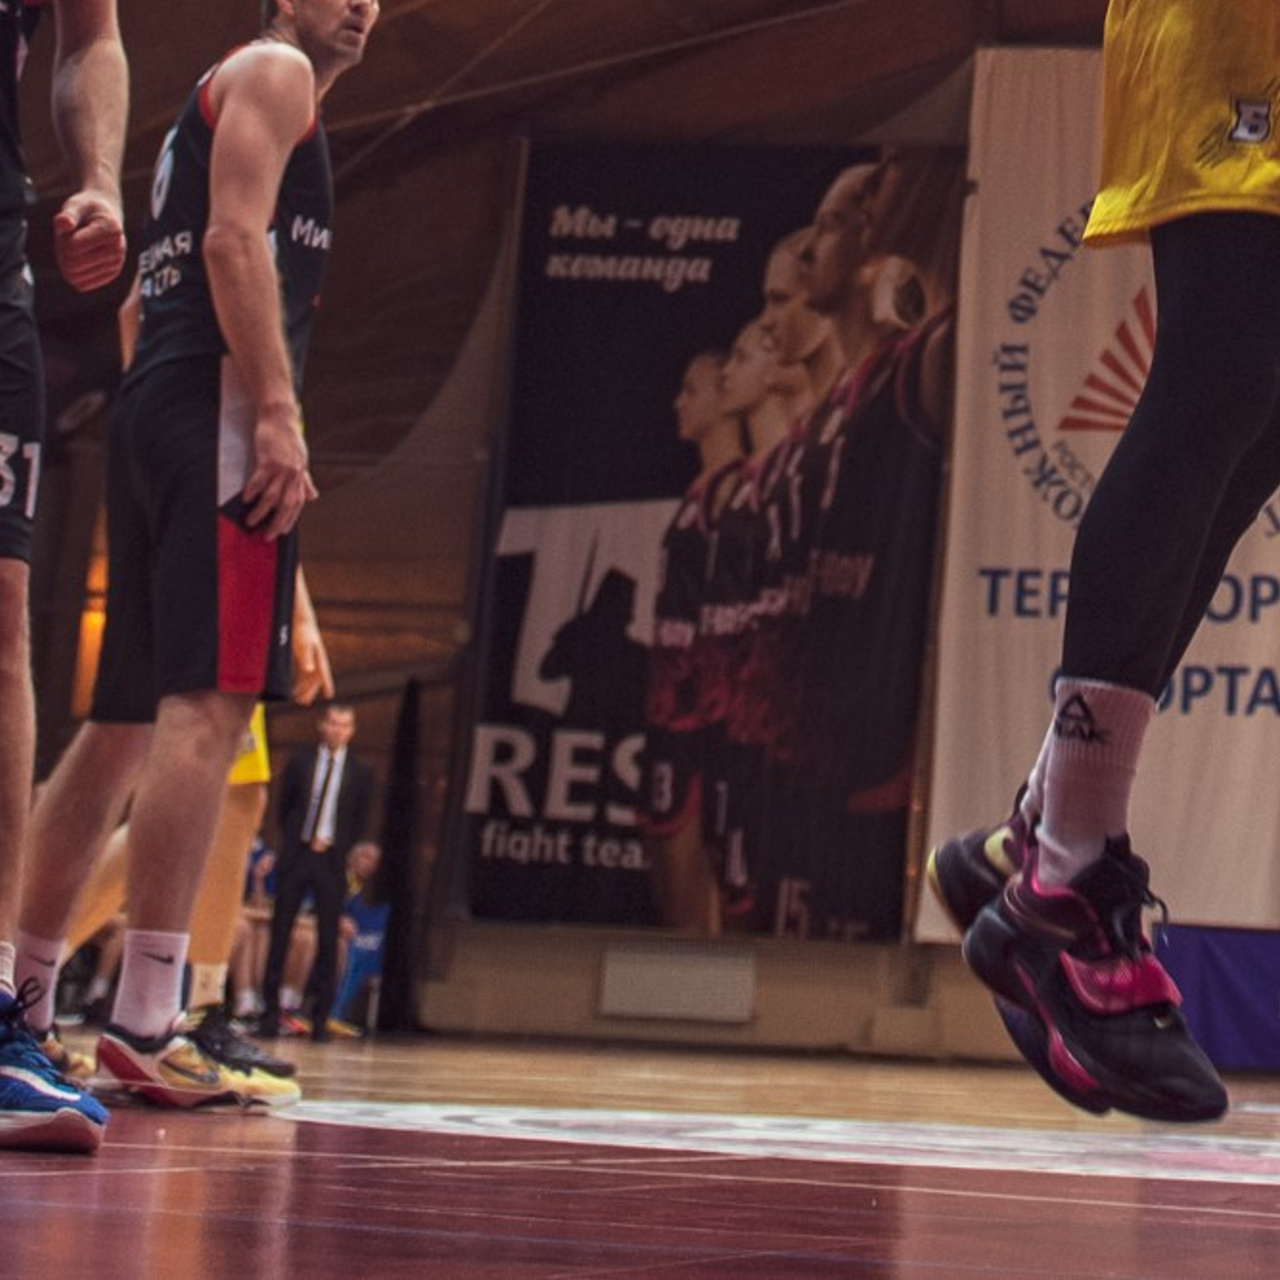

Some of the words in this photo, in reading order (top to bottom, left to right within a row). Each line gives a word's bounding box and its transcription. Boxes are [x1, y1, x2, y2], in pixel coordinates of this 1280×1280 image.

[551, 206, 617, 237] Мы
[650, 216, 740, 251] одна
[547, 255, 712, 292] команда
[483, 820, 570, 865] fight
[584, 838, 648, 870] tea
